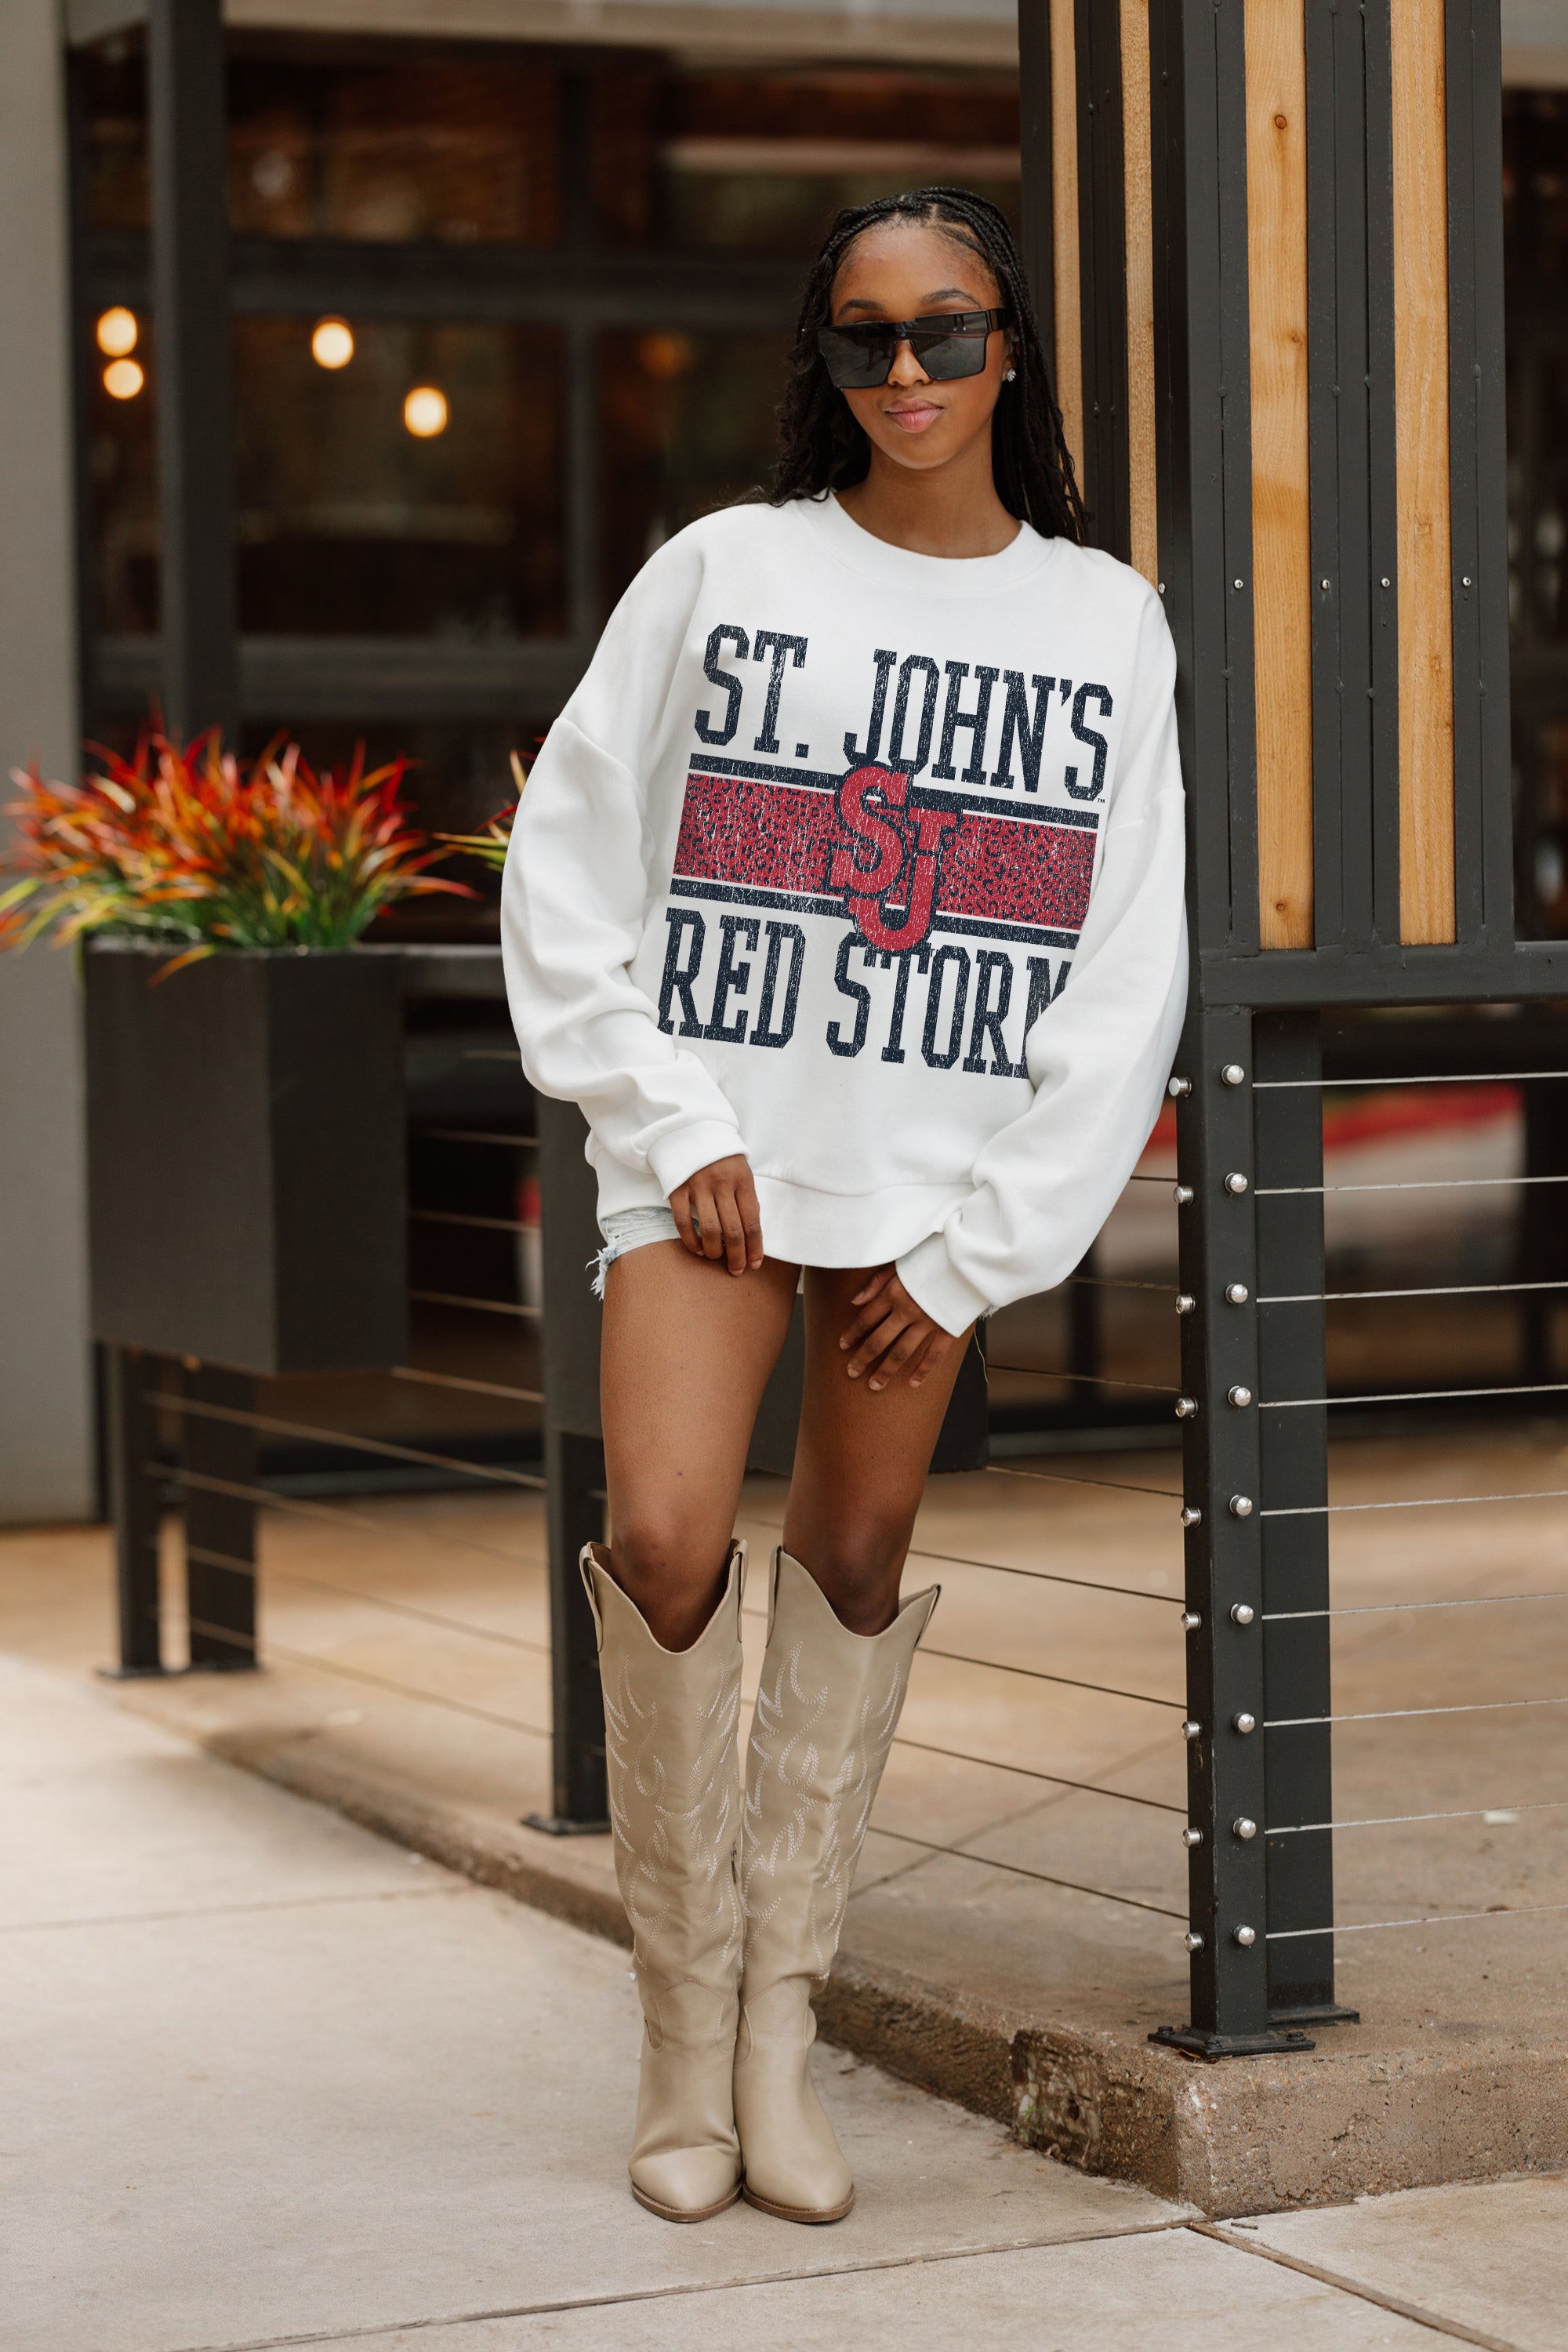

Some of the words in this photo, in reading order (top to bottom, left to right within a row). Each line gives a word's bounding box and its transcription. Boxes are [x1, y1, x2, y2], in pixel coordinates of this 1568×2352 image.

[694, 623, 809, 759] ST.
[843, 648, 1113, 801] JOHN'S
[657, 906, 806, 1049] RED
